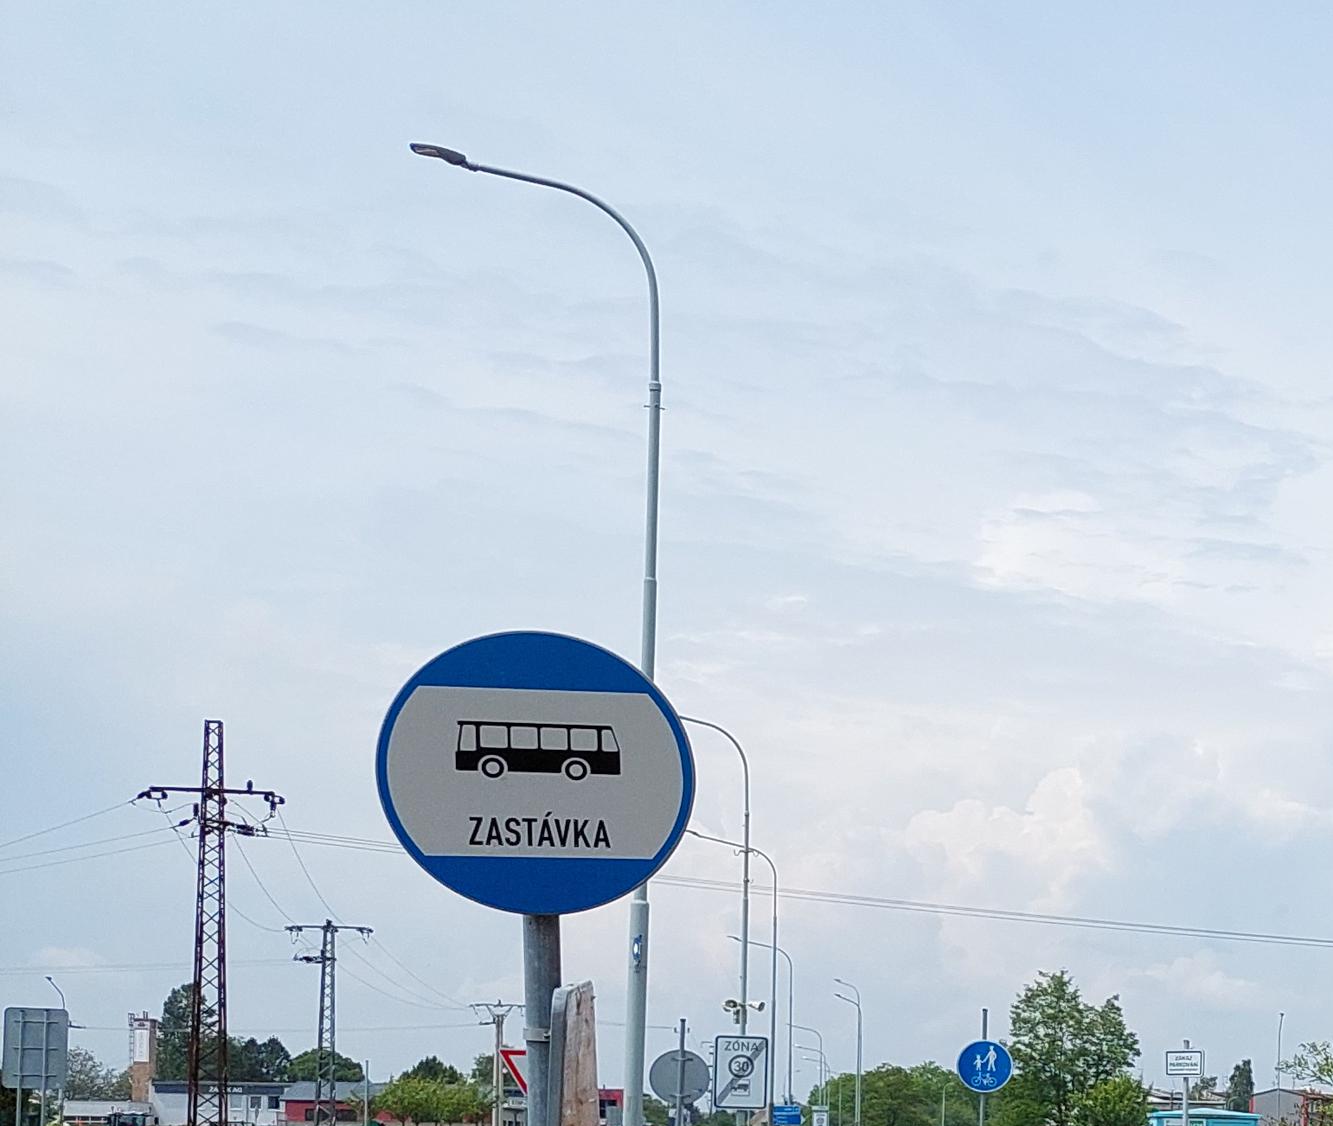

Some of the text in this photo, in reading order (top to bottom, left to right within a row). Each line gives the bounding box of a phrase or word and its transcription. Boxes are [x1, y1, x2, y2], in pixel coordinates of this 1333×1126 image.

[468, 811, 612, 849] ZASTÁVKA
[724, 1040, 760, 1052] ZÓNA
[733, 1060, 749, 1073] 30
